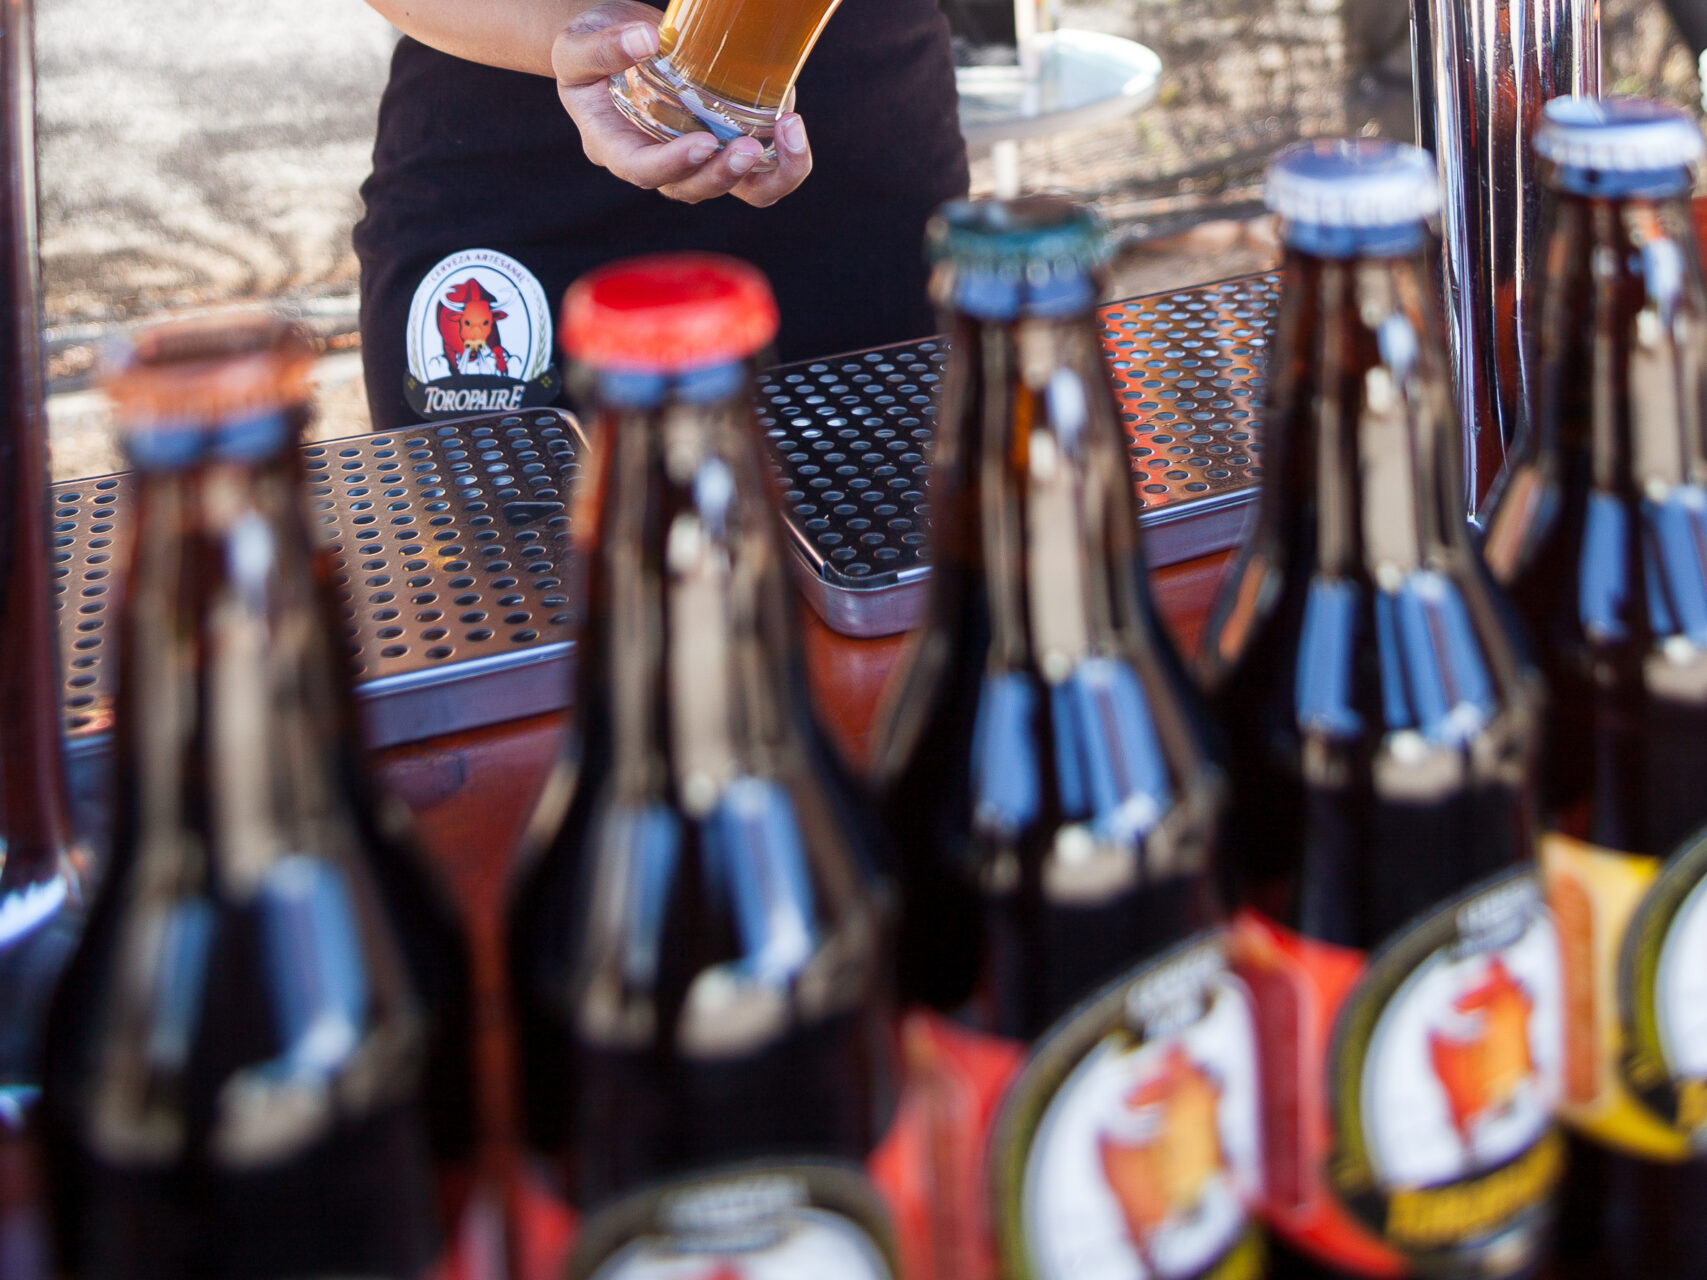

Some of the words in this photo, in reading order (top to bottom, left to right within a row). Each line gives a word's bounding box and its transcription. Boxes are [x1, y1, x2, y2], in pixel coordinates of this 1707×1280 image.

[430, 254, 471, 282] CERVEZA
[474, 253, 527, 283] ARTESANAL
[424, 384, 525, 413] TOROPAIRE
